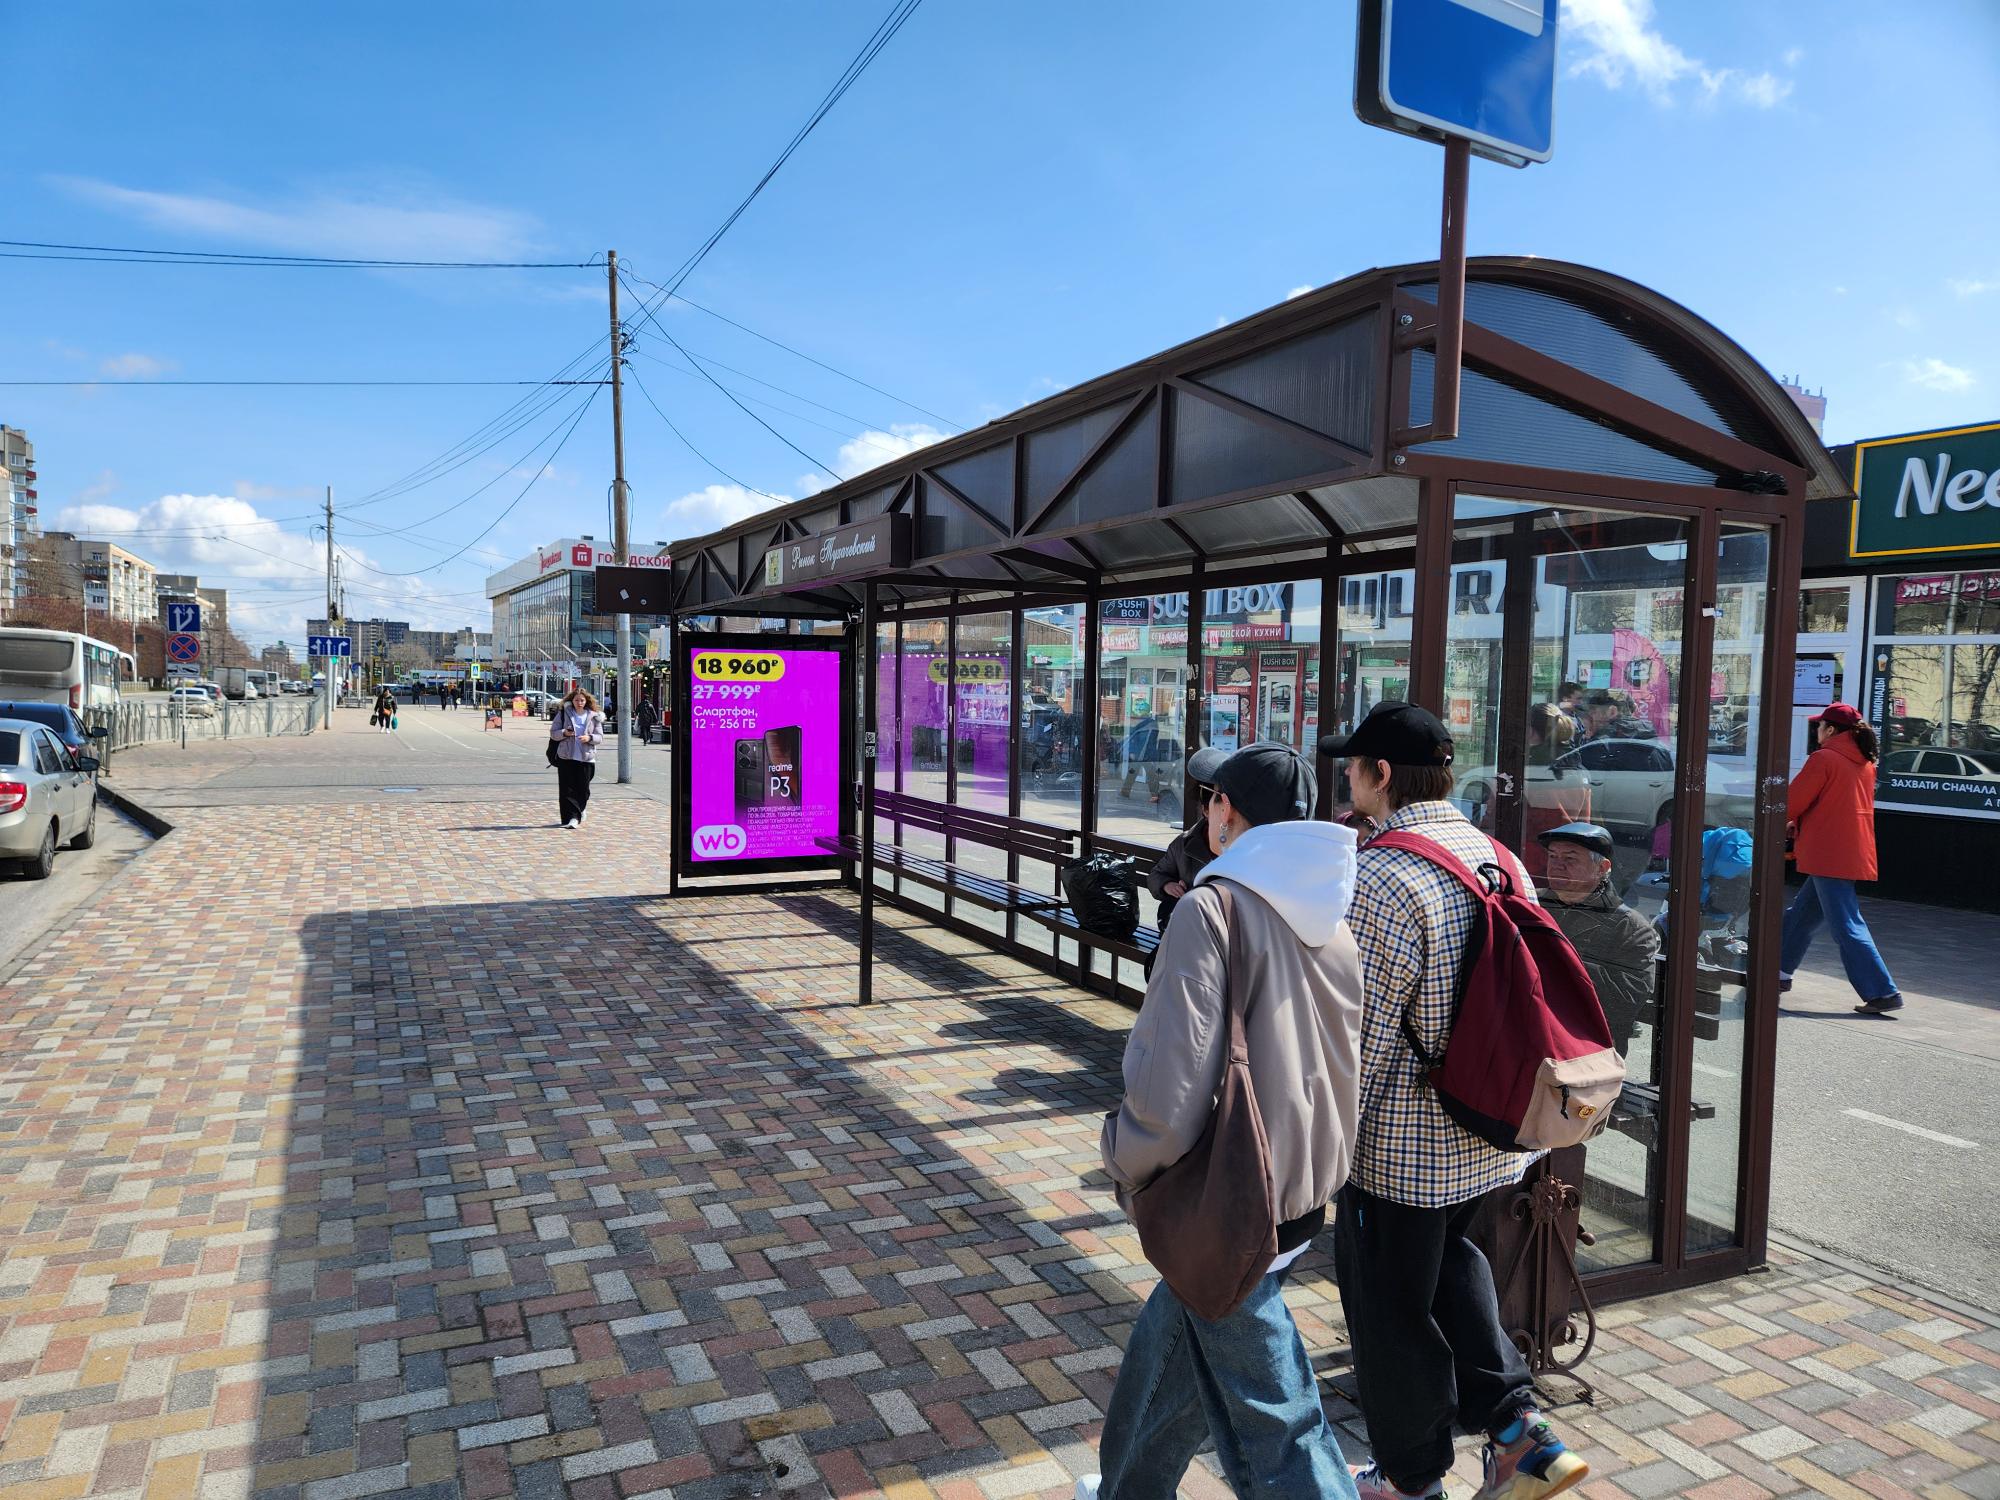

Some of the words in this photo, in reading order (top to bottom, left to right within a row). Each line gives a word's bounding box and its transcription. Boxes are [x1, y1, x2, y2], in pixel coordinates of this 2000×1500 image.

[598, 553, 671, 568] ГОДСКОЙ
[1117, 600, 1146, 609] SUSHI
[1227, 583, 1287, 614] BOX
[1121, 610, 1141, 618] BOX
[1254, 627, 1282, 637] КУХНИ
[698, 658, 722, 674] 18
[1263, 658, 1280, 666] SUSHI
[1282, 658, 1295, 666] BOX
[1816, 674, 1831, 684] t2
[693, 685, 714, 699] 27
[1872, 677, 1886, 723] ЛИМОНАДЫ
[694, 706, 758, 718] Смартфон,
[694, 719, 706, 728] 12
[720, 719, 739, 728] 256
[742, 719, 756, 728] ГБ
[768, 763, 793, 772] realme
[770, 776, 790, 797] P3
[1891, 778, 1939, 790] ЗАХВАТИ
[1942, 781, 1997, 795] СНАЧАЛА
[699, 827, 740, 850] wb
